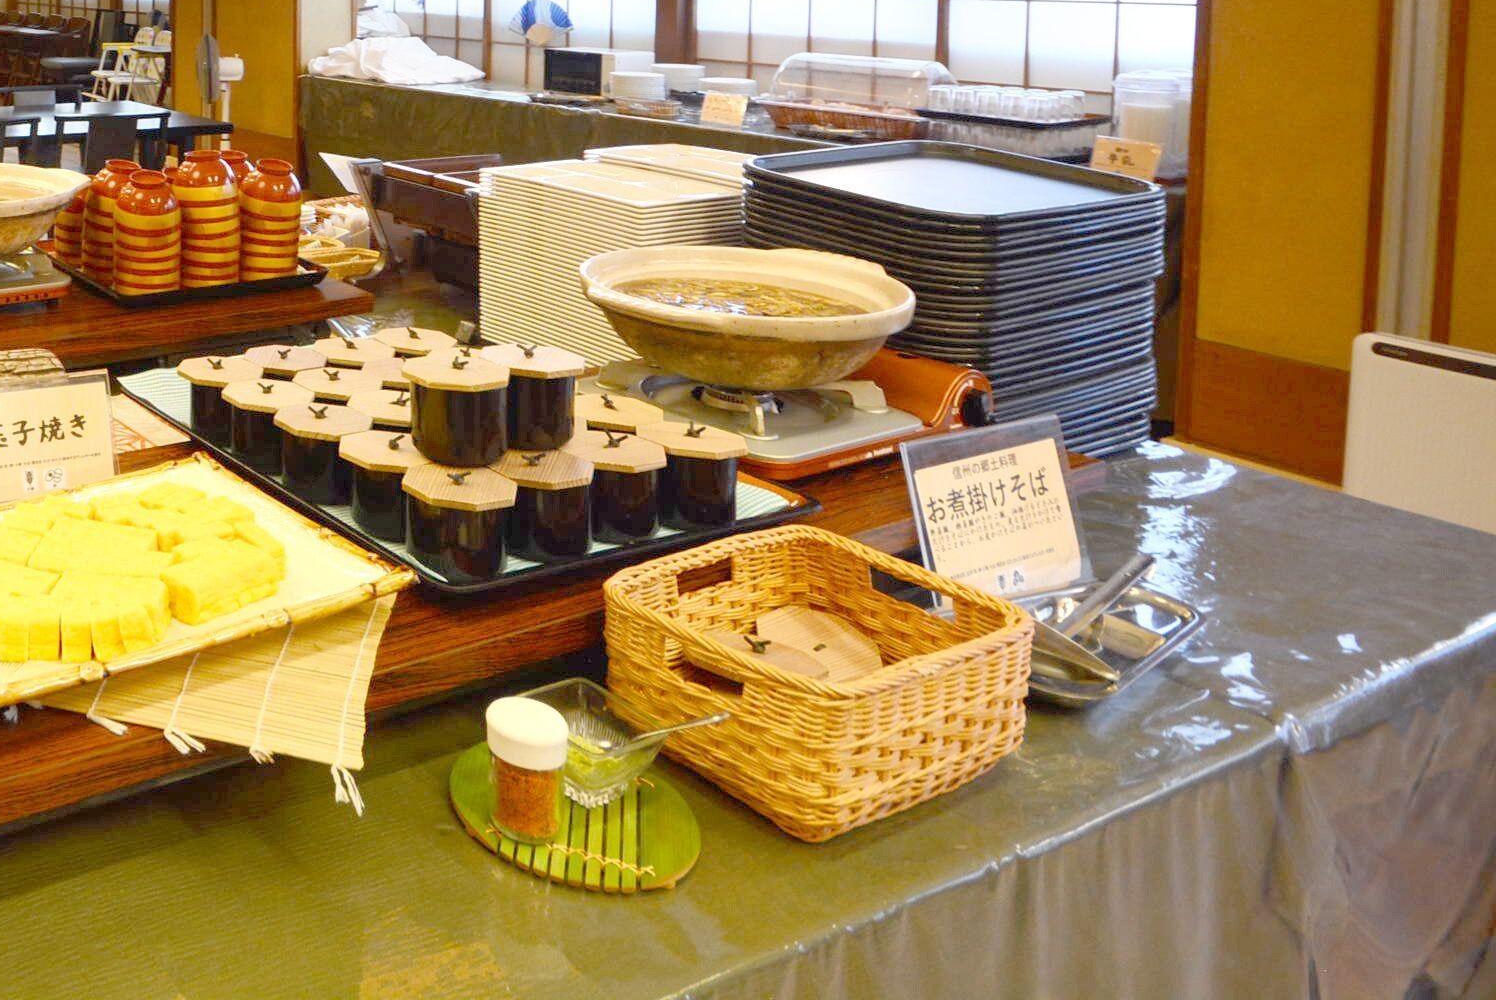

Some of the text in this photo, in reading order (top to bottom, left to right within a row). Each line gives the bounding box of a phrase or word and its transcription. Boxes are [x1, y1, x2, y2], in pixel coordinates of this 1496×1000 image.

[925, 465, 1050, 524] お煮掛けそば
